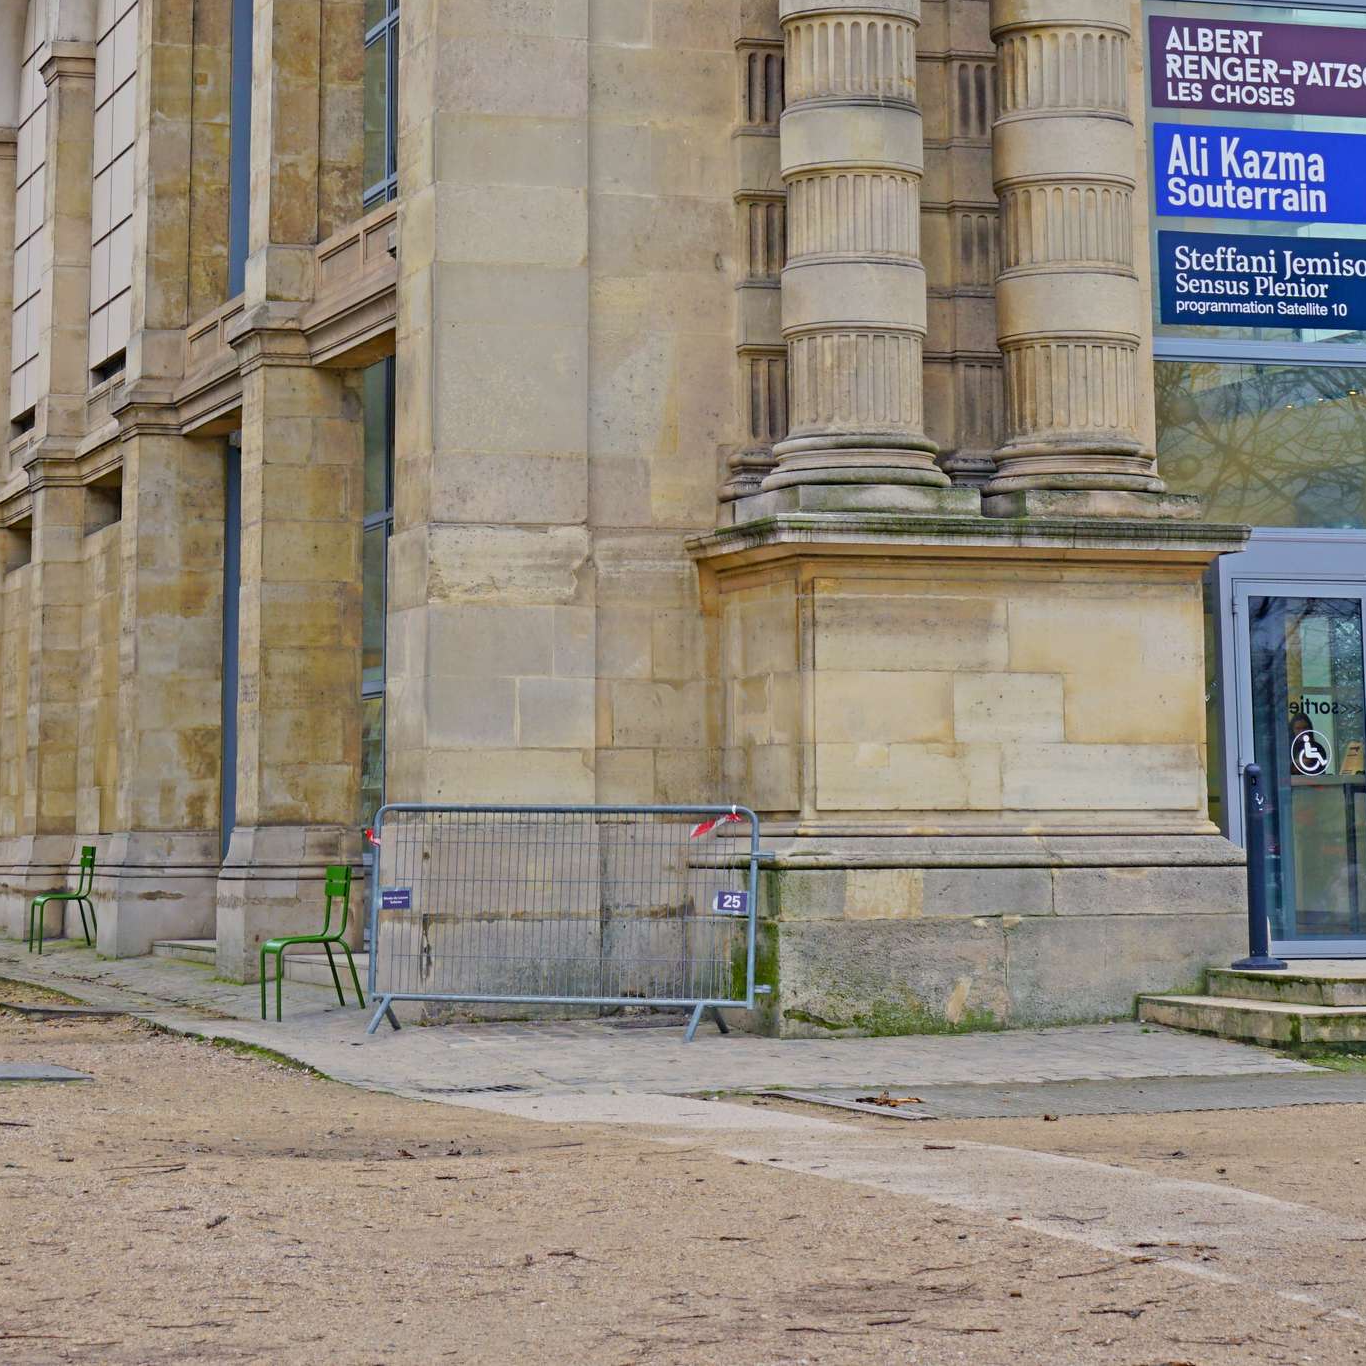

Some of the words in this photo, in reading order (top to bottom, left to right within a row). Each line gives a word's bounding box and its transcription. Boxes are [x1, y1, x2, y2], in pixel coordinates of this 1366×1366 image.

[1165, 26, 1263, 55] ALBERT
[1167, 81, 1203, 102] LES
[1210, 83, 1296, 107] CHOSES
[1167, 133, 1209, 177] Ali
[1220, 136, 1325, 183] Kazma
[1167, 176, 1327, 213] Souterrain
[1175, 245, 1278, 274] Steffani
[1175, 272, 1250, 296] Sensus
[1254, 276, 1329, 298] Plenior
[1175, 300, 1274, 315] programmation
[1277, 301, 1328, 316] Satellite
[1331, 303, 1348, 317] 10
[722, 694, 741, 709] 25
